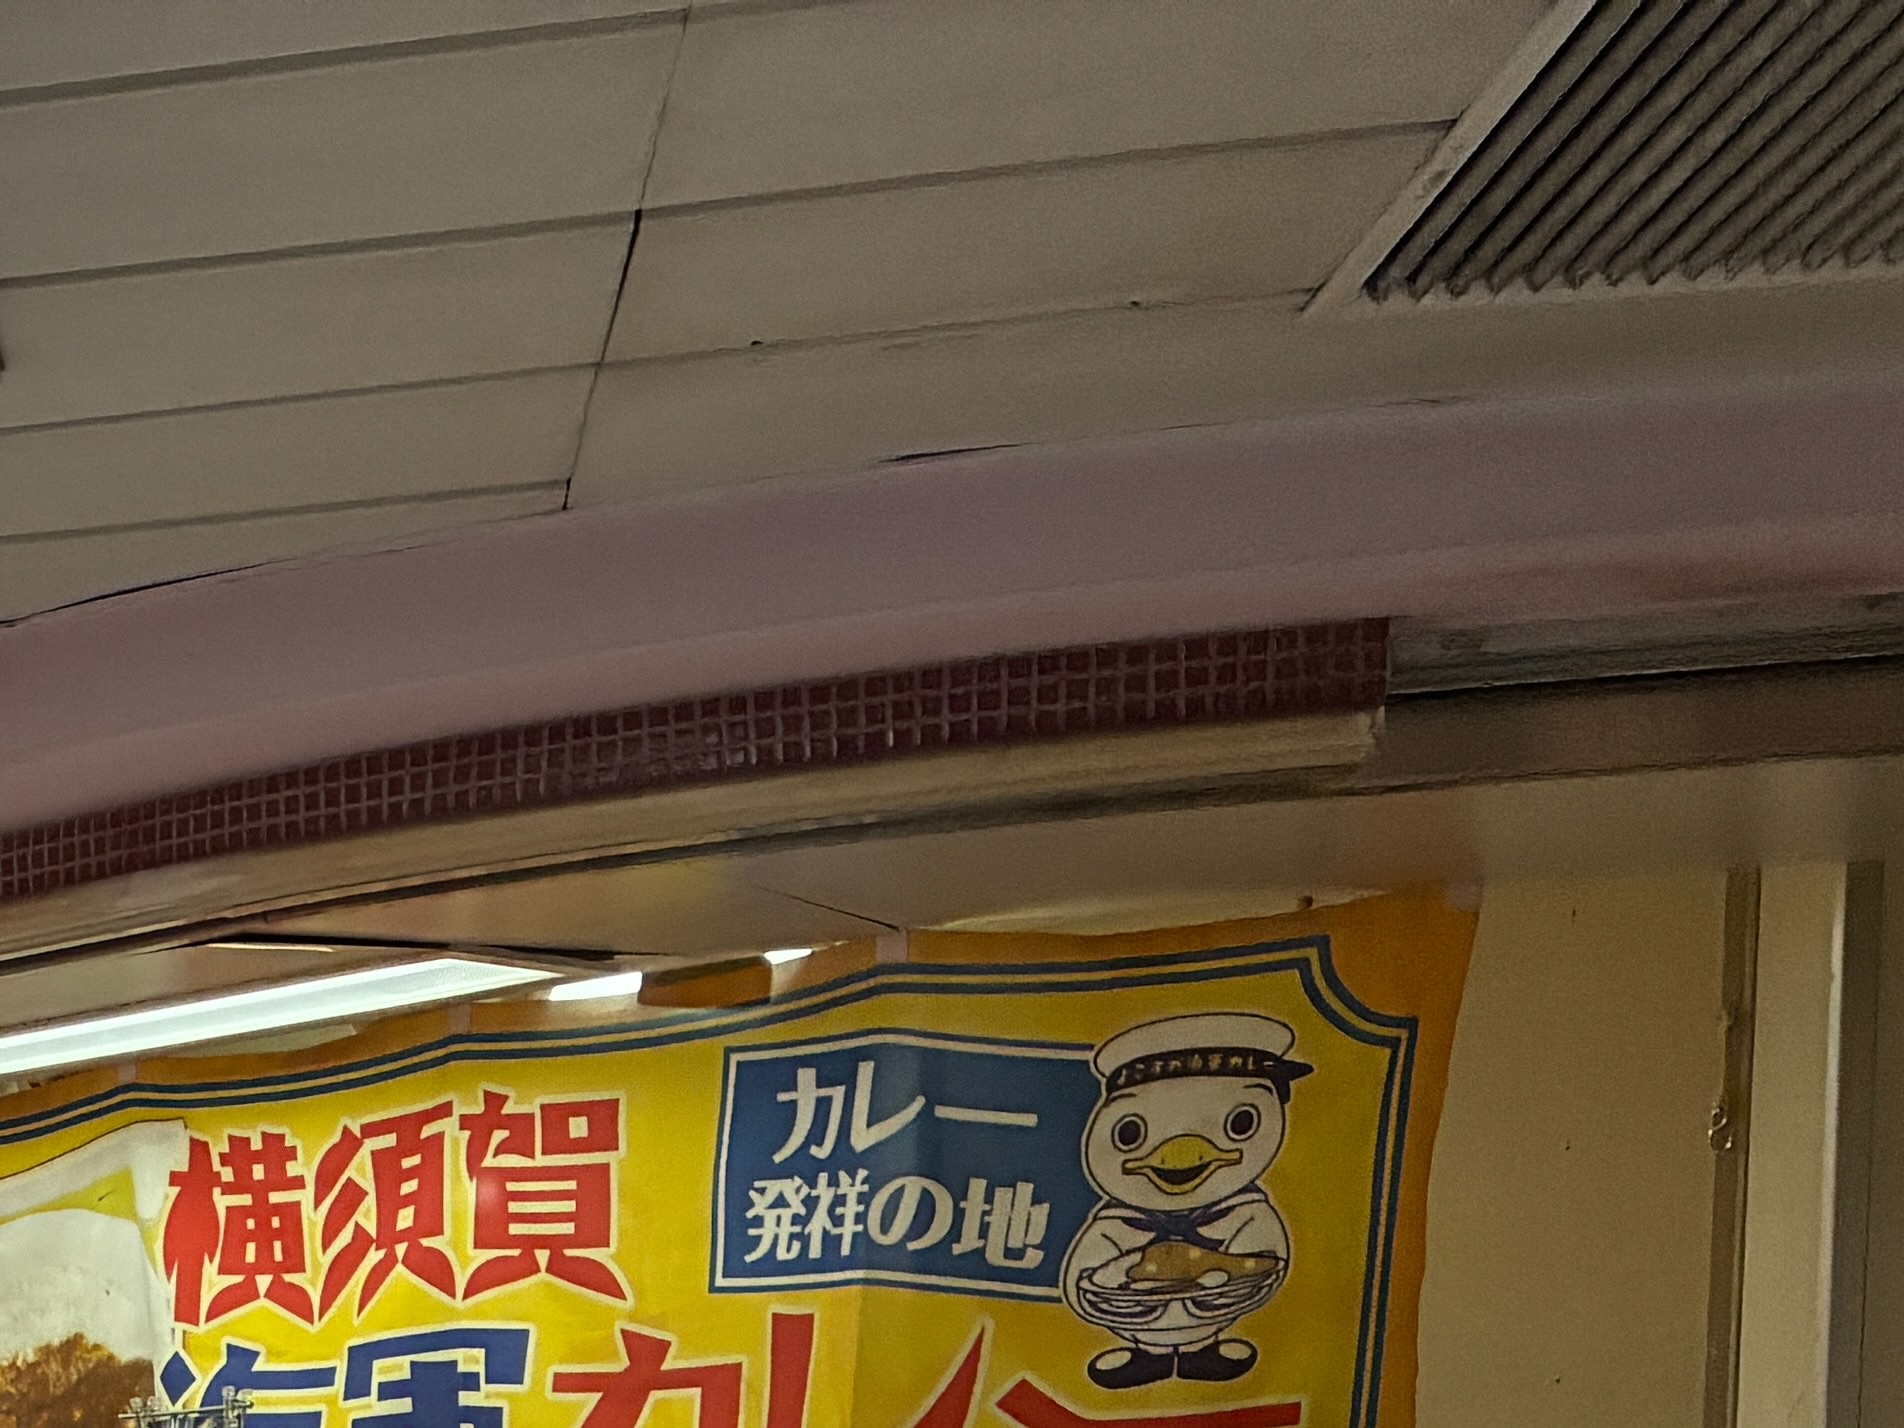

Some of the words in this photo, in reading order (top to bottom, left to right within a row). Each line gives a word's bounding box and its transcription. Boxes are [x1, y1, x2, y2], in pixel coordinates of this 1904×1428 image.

[775, 1059, 1038, 1164] カレー
[163, 1087, 631, 1327] 横須賀
[746, 1169, 1051, 1268] 発祥の地
